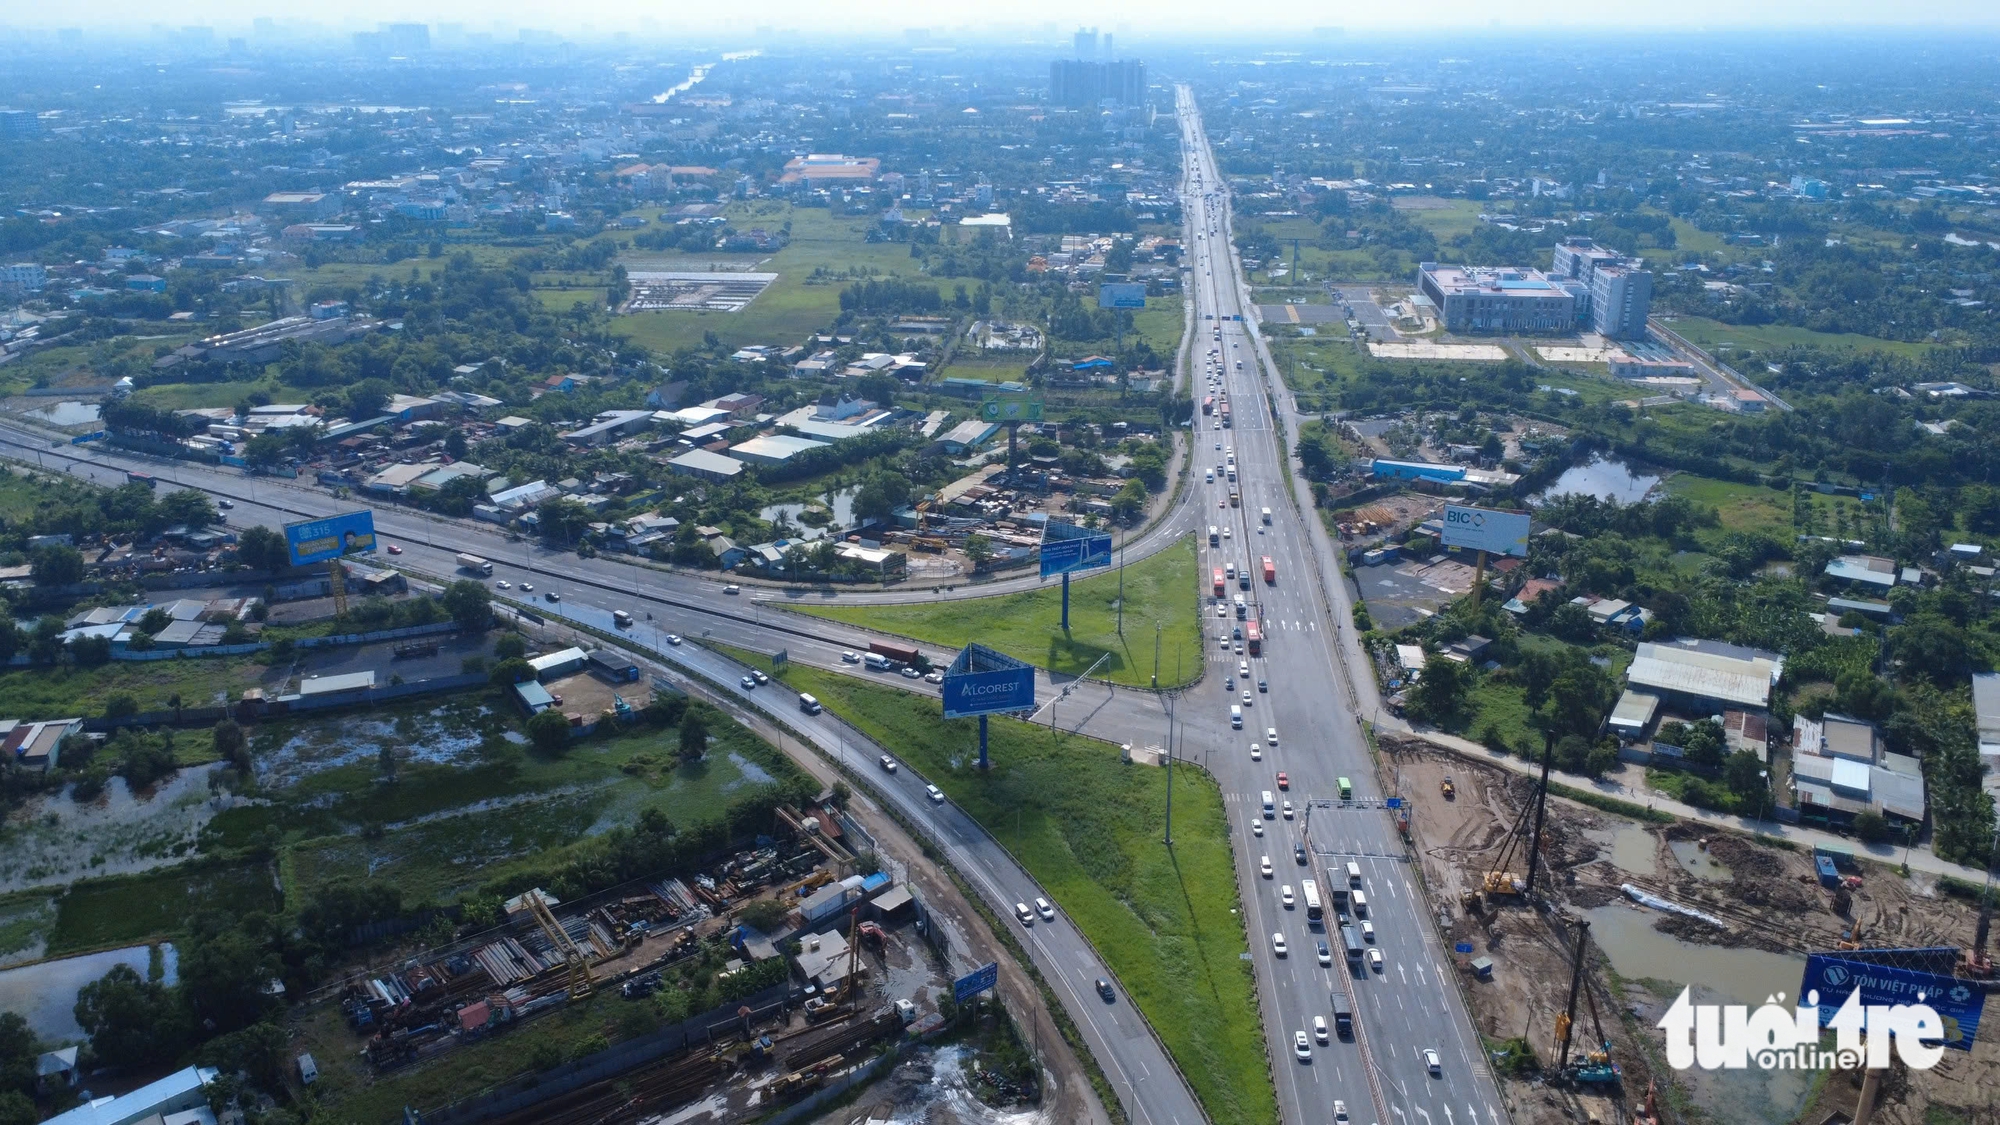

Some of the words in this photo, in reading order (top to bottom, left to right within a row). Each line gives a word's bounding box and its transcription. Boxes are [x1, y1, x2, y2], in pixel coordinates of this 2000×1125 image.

[961, 681, 1019, 697] ALCOREST
[1852, 974, 1877, 988] TÔN
[1880, 979, 1906, 994] VIỆT
[1909, 983, 1944, 998] PHÁP
